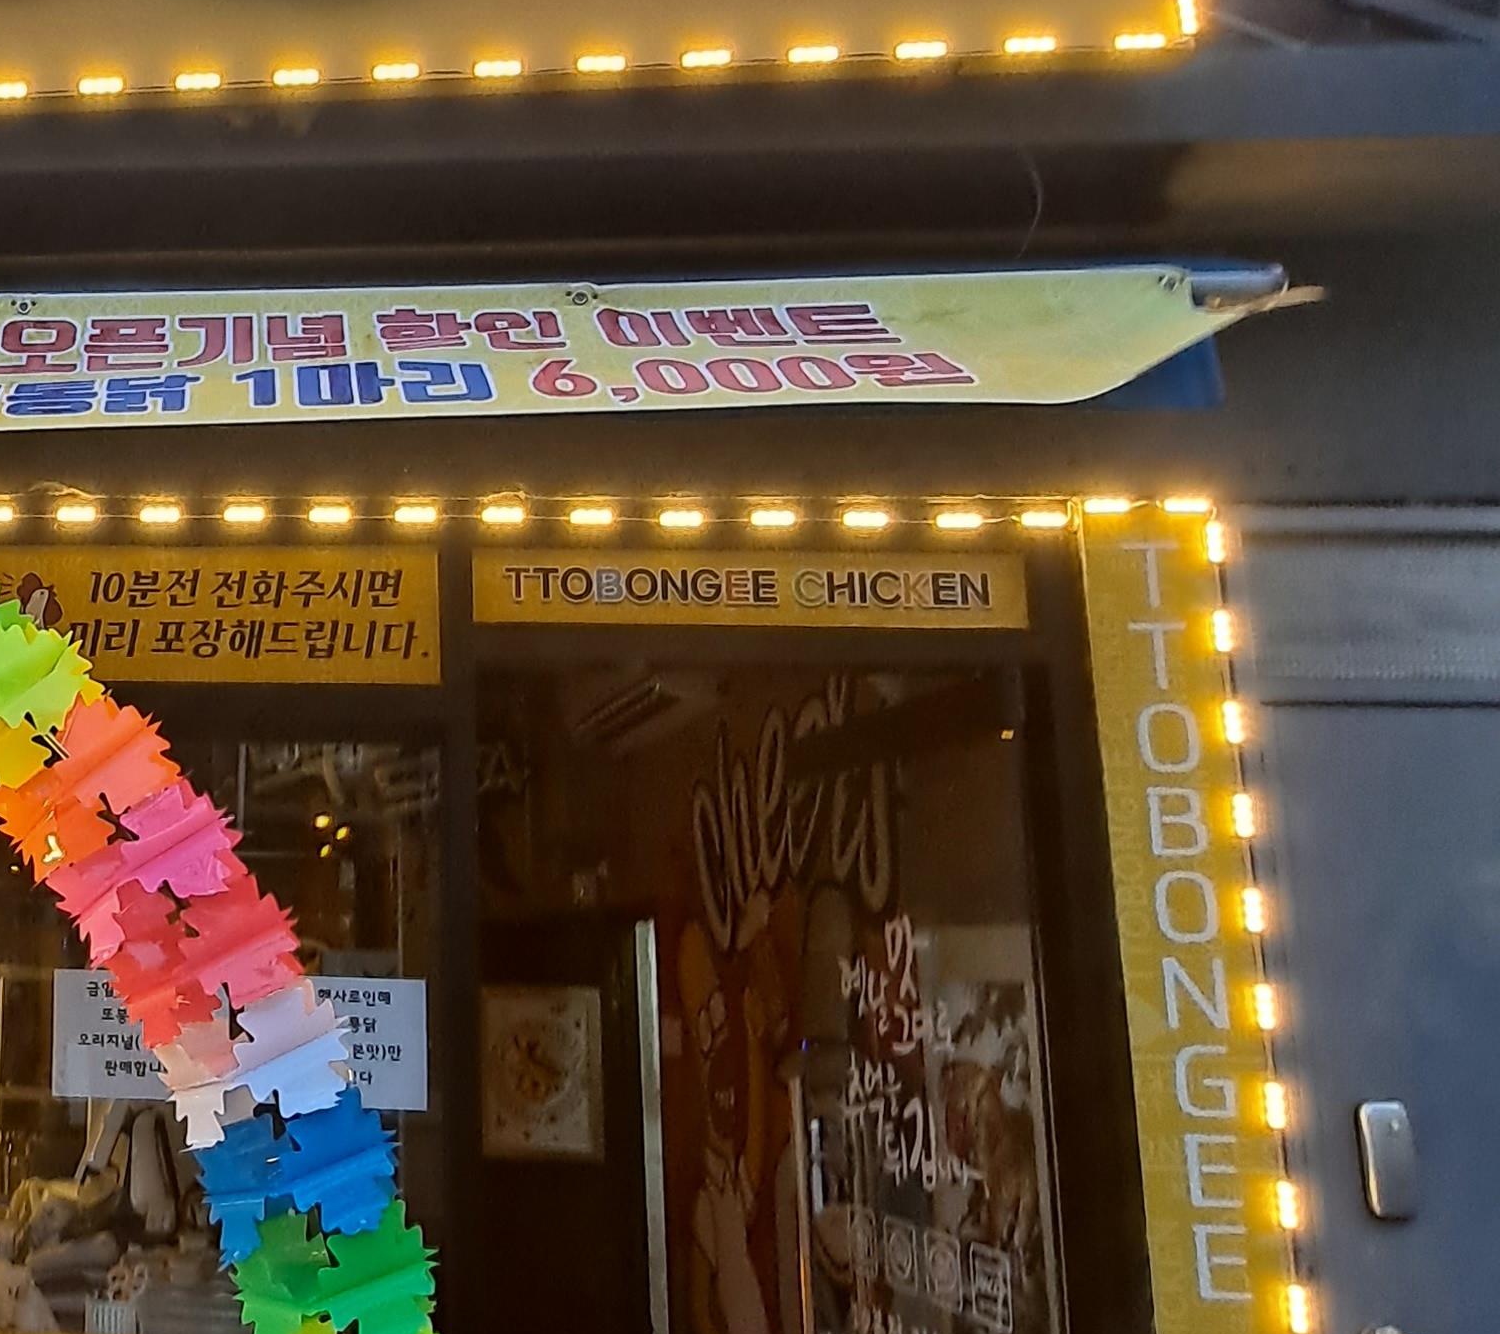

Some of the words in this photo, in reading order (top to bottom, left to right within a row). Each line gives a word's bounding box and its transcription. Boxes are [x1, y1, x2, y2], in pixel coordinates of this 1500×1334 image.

[376, 305, 567, 354] 할인
[598, 301, 902, 348] 이벤트
[232, 358, 498, 411] 1마리
[530, 352, 977, 405] 6,000원
[90, 570, 199, 609] 10분전
[505, 567, 778, 606] TTOBONGEE
[794, 568, 992, 608] CHICKEN
[72, 621, 140, 658] 미리
[151, 620, 429, 660] 포장해드립니다.
[1121, 541, 1252, 1302] TTOBONGEE
